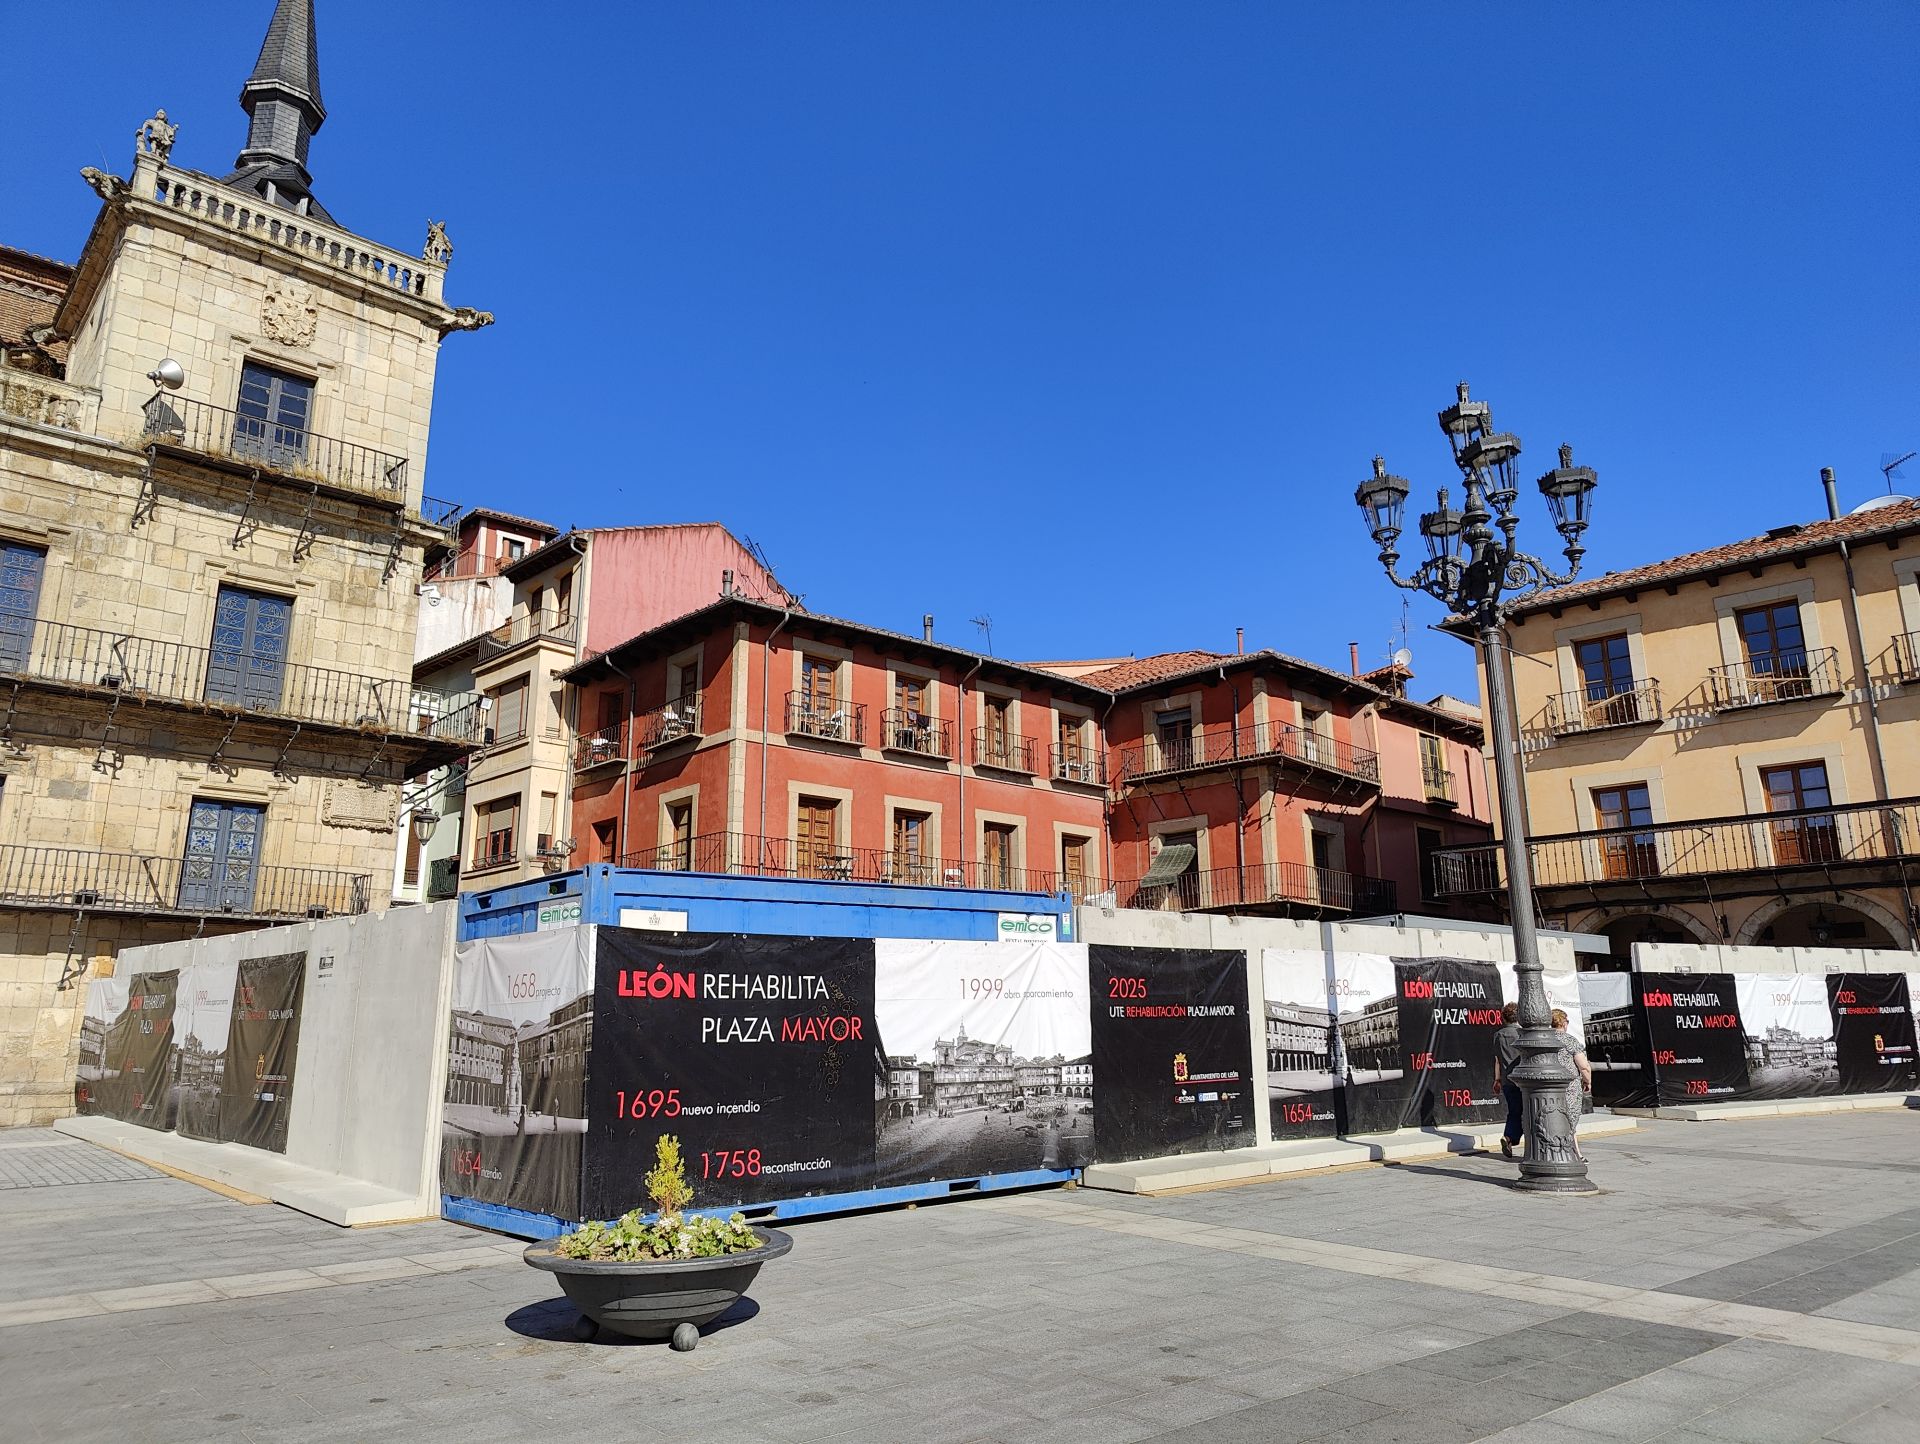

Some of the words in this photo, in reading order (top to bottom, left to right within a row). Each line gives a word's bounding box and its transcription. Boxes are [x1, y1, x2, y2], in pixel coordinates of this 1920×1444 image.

[1001, 921, 1052, 932] emico
[508, 973, 536, 998] 1658
[618, 963, 696, 998] LEÓN
[703, 974, 829, 999] REHABILITA
[960, 978, 1003, 1000] 1999
[1109, 978, 1146, 998] 2025
[1322, 979, 1349, 995] 1658
[1404, 976, 1432, 998] LEÓN
[1434, 982, 1486, 998] REHABILITA
[1644, 989, 1672, 1006] LEÓN
[1673, 994, 1720, 1006] REHABILITA
[1110, 1006, 1125, 1017] UTE
[1127, 1004, 1186, 1017] REHABILITACIÓN
[1188, 1006, 1208, 1016] PLAZA
[1209, 1005, 1235, 1016] MAYOR
[1434, 1008, 1467, 1024] PLAZA
[1468, 1009, 1502, 1025] MAYOR
[702, 1018, 774, 1043] PLAZA
[781, 1016, 863, 1042] MAYOR
[1676, 1016, 1704, 1028] PLAZA
[1704, 1015, 1736, 1028] MAYOR
[1411, 1053, 1433, 1070] 1695
[1652, 1051, 1675, 1064] 1695
[1686, 1081, 1708, 1094] 1758
[616, 1090, 681, 1118] 1695
[682, 1105, 713, 1116] nuevo
[717, 1100, 761, 1114] incendio
[1444, 1090, 1471, 1106] 1758
[1282, 1104, 1312, 1122] 1654
[1312, 1110, 1334, 1120] incendio
[453, 1149, 481, 1176] 1654
[481, 1166, 502, 1180] incendio
[701, 1149, 762, 1179] 1758
[762, 1158, 831, 1174] reconstrucción
